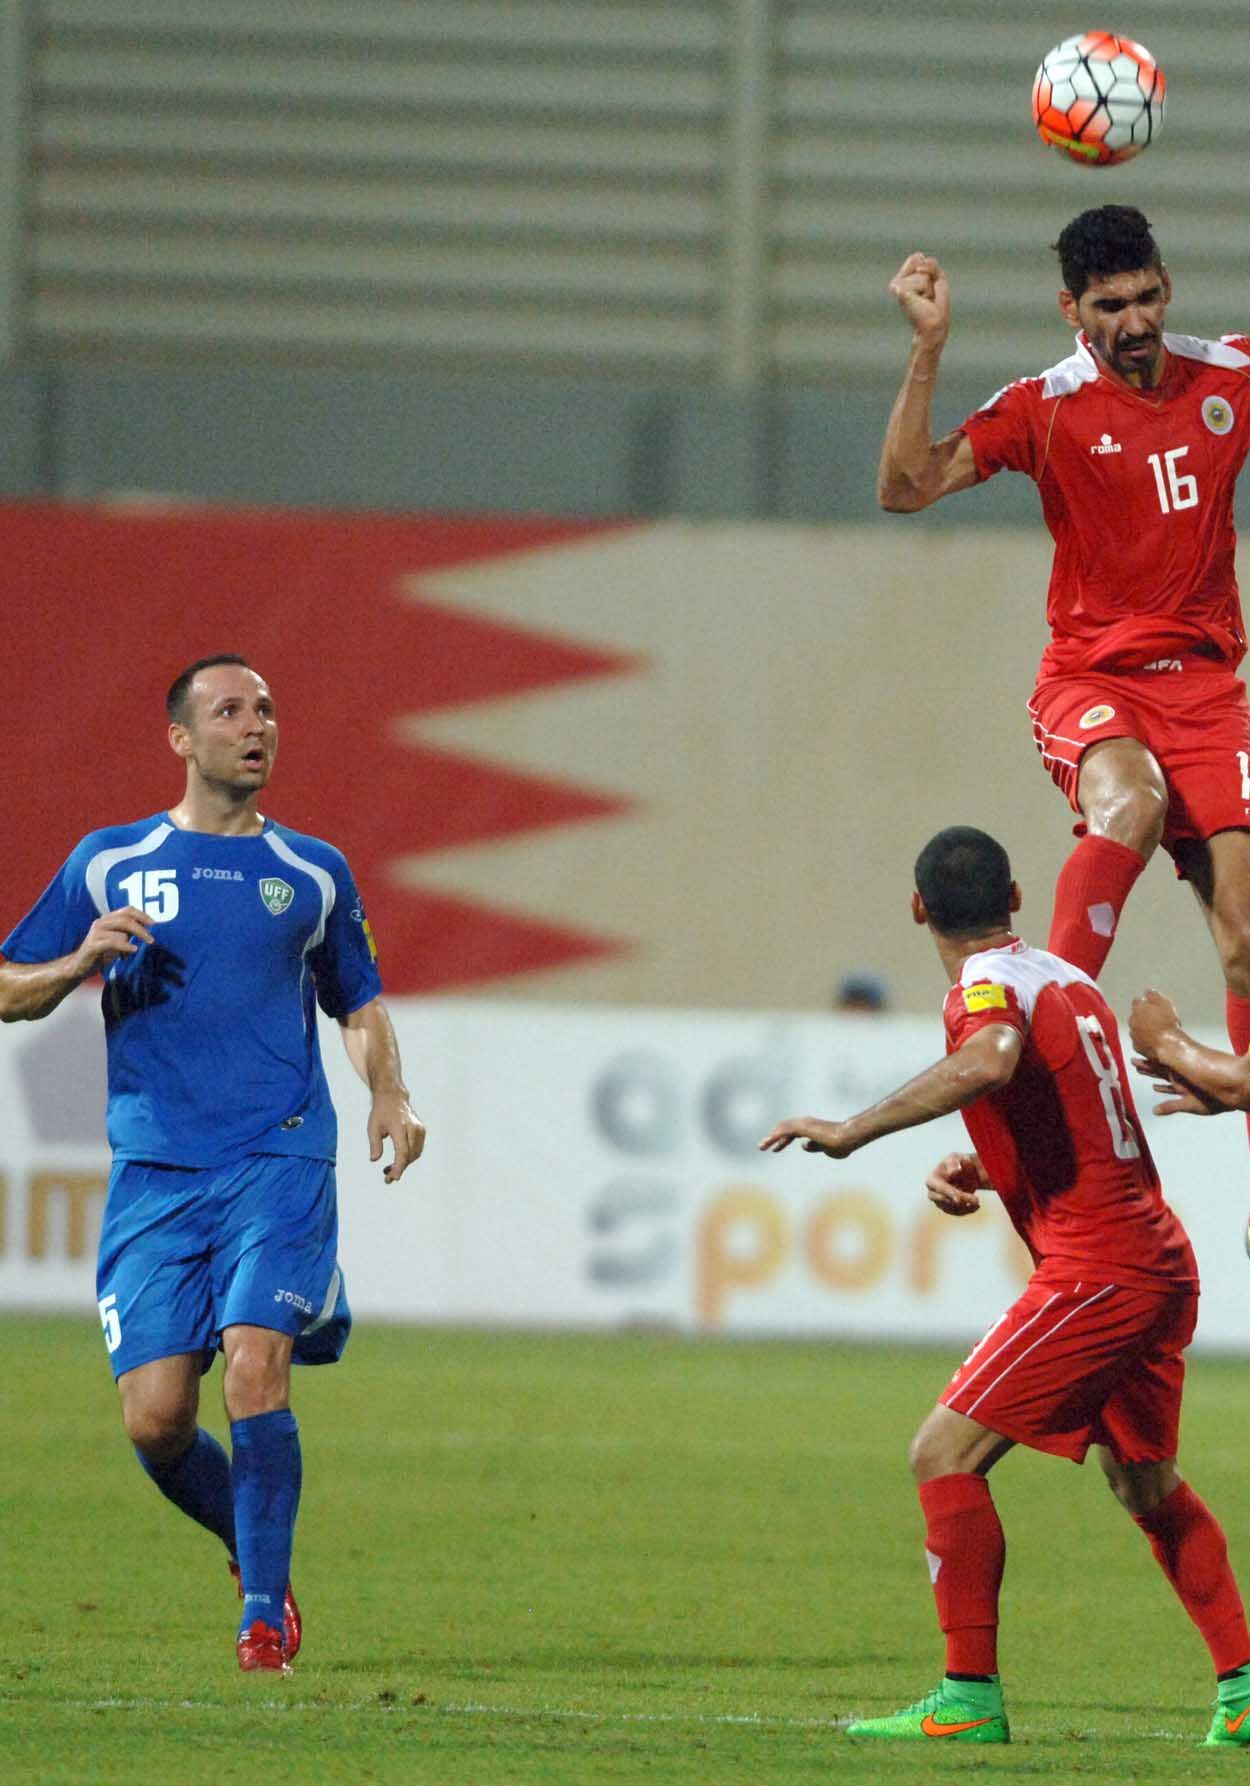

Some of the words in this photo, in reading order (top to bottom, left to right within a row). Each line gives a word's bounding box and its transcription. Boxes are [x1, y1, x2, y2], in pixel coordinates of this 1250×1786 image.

[1147, 445, 1200, 514] 16
[118, 869, 180, 923] 15
[264, 883, 290, 901] UFF
[1075, 1014, 1140, 1160] 8
